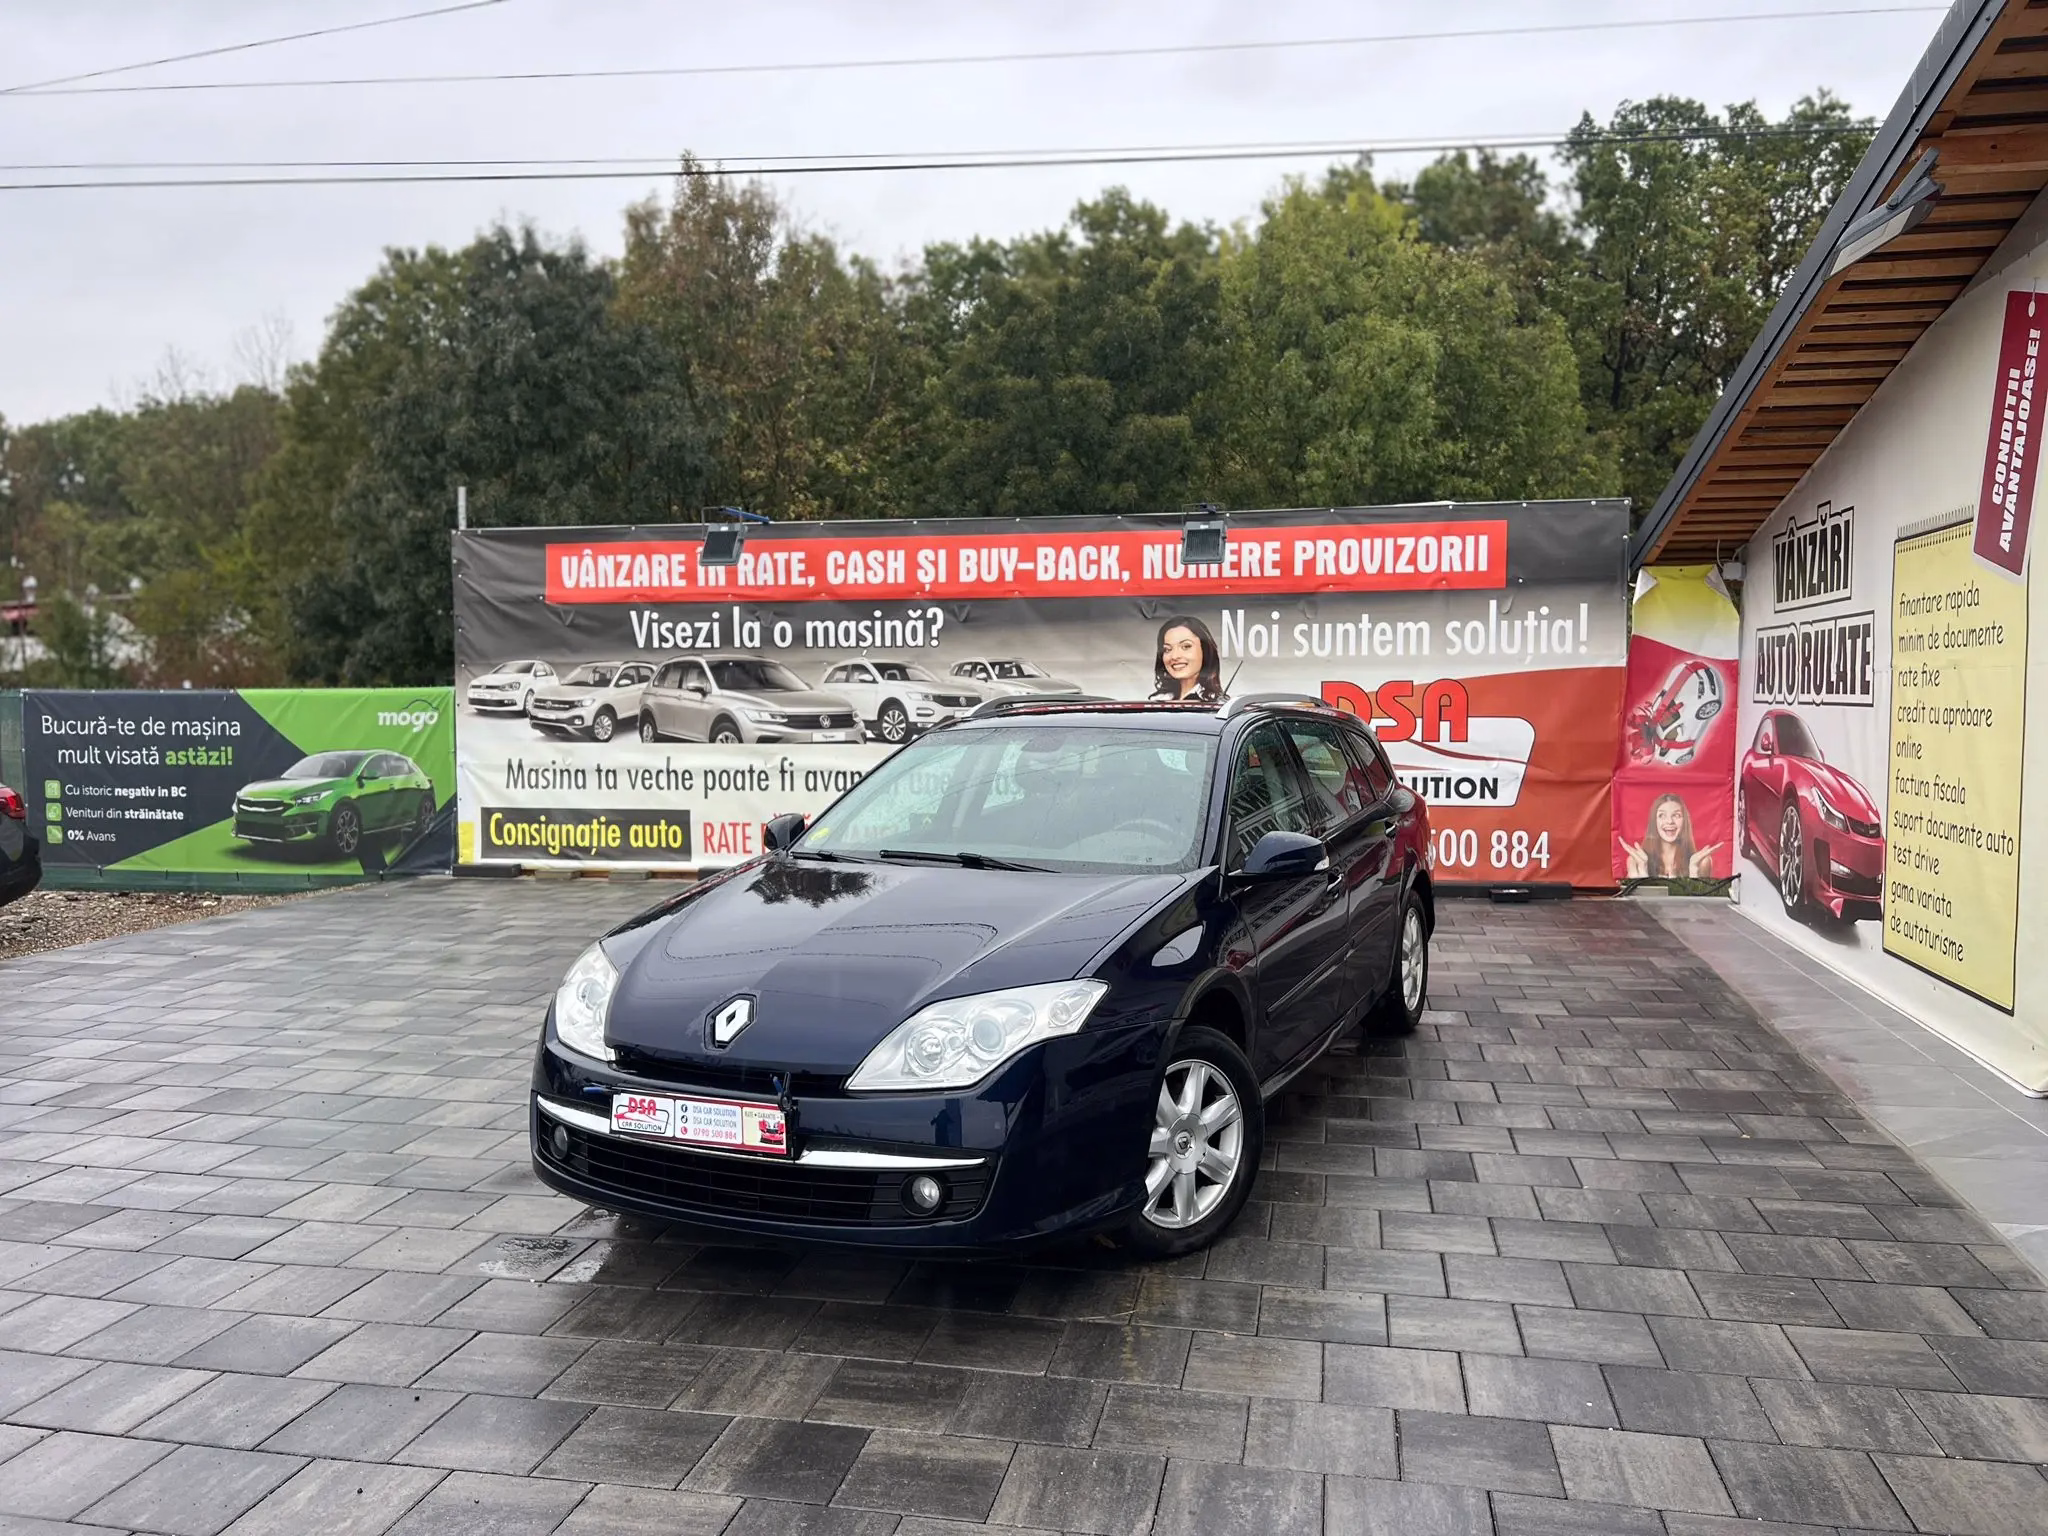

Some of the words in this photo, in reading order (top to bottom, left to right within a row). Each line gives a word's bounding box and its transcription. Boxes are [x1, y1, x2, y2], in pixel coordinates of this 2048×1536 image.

[561, 549, 686, 588] VÂNZARE
[738, 551, 816, 588] RATE,
[826, 549, 905, 584] CASH
[917, 548, 947, 591] ȘI
[959, 543, 1131, 584] BUY-BACK,
[1294, 535, 1488, 576] PROVIZORII
[1775, 514, 1850, 604] VÂNZĂRI
[1899, 593, 1942, 618] finantare
[1945, 580, 1980, 617] rapida
[630, 610, 720, 649] Visezi
[733, 606, 761, 648] la
[773, 622, 793, 648] o
[1221, 609, 1280, 658] Noi
[1294, 614, 1430, 657] suntem
[1445, 600, 1588, 665] soluția!
[1898, 628, 1925, 652] minim
[1927, 627, 1940, 650] de
[1943, 620, 2004, 649] documente
[1898, 667, 1918, 688] rate
[1921, 662, 1940, 687] fixe
[377, 711, 439, 733] mogo
[1321, 679, 1468, 742] DSA
[1897, 699, 1926, 724] credit
[1929, 706, 1940, 725] cu
[1942, 700, 1993, 733] aprobare
[41, 715, 135, 736] Bucură-te
[141, 716, 165, 736] de
[171, 717, 241, 741] mașina
[58, 745, 101, 765] mult
[105, 746, 159, 765] visată
[165, 746, 233, 766] astăzi!
[1896, 735, 1922, 760] online
[65, 785, 80, 796] Cu
[82, 785, 112, 796] istoric
[114, 786, 155, 799] negativ
[158, 786, 169, 797] in
[171, 786, 187, 797] BC
[506, 758, 587, 790] Masina
[595, 763, 619, 790] ta
[627, 762, 694, 791] veche
[704, 763, 770, 799] poate
[779, 757, 795, 791] fi
[1895, 768, 1930, 798] factura
[1932, 774, 1966, 805] fiscala
[65, 807, 103, 819] Venituri
[106, 808, 122, 819] din
[124, 809, 184, 820] străinătate
[67, 830, 84, 841] 0%
[86, 831, 116, 842] Avans
[490, 812, 621, 855] Consignație
[629, 819, 683, 848] auto
[703, 822, 752, 854] RATE
[1490, 830, 1550, 869] 884
[1893, 809, 1923, 837] suport
[1926, 811, 1982, 848] documente
[1986, 829, 2014, 857] auto
[1893, 841, 1911, 866] test
[1914, 846, 1940, 876] drive
[1891, 879, 1914, 904] gama
[1917, 888, 1952, 919] variata
[1890, 909, 1901, 933] de
[1903, 919, 1964, 962] autoturisme
[628, 1097, 657, 1116] DSA
[703, 1107, 712, 1115] CAR
[713, 1108, 737, 1117] SOLUTION
[704, 1117, 712, 1126] CAR
[713, 1119, 737, 1128] SOLUTION
[634, 1122, 662, 1132] SOLUTION
[693, 1128, 710, 1137] 0790
[712, 1129, 723, 1138] 500
